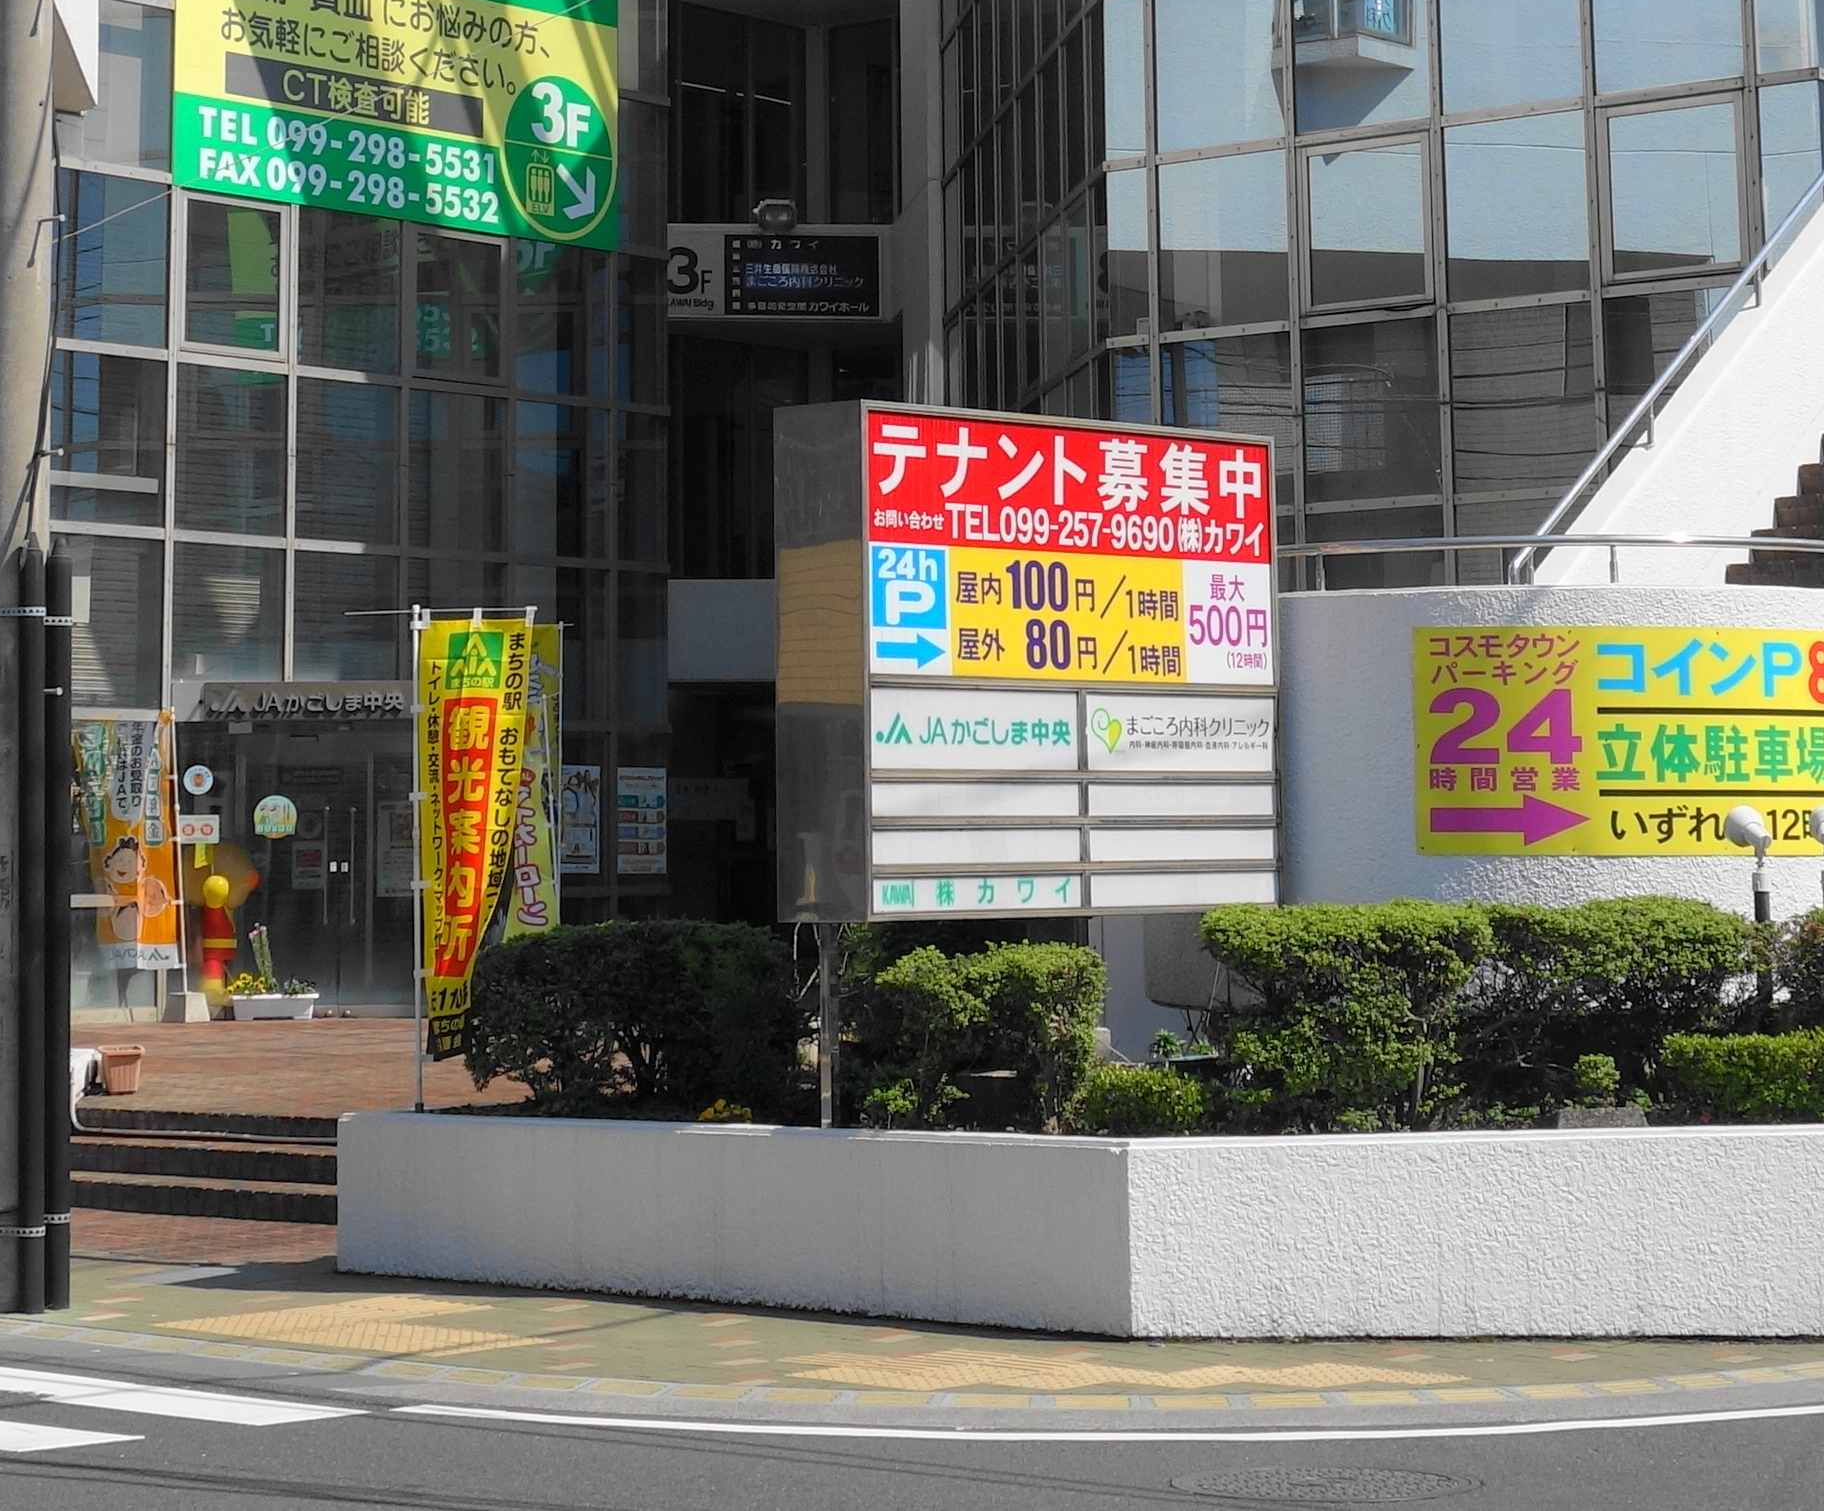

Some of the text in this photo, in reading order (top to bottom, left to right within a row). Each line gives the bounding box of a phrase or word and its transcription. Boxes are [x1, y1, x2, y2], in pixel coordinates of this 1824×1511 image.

[220, 7, 518, 96] お気軽にご相談ください。
[282, 73, 432, 126] CT検査可能
[530, 81, 593, 148] 3F
[198, 106, 497, 185] TEL 099-298-5531
[198, 147, 501, 225] FAX 099-298-5532
[872, 422, 1264, 521] テナント募集中
[873, 507, 945, 531] お問い合わせ
[945, 502, 1175, 553] TEL099-257-9690
[877, 547, 939, 582] 24h
[1208, 573, 1245, 602] 最大
[884, 582, 938, 625] P
[1188, 603, 1270, 650] 500円
[956, 626, 1005, 664] 屋外
[1225, 649, 1269, 672] (12時間)
[1428, 633, 1581, 660] コスモタウン
[1596, 637, 1803, 699] コインP
[501, 631, 527, 712] まちの駅
[1429, 660, 1579, 687] パーキング
[255, 691, 405, 713] JAかごしま中央
[917, 715, 1072, 748] JAかごしま中央
[1125, 713, 1271, 739] まごころ内科クリニック
[1428, 687, 1583, 766] 24
[1428, 768, 1582, 793] 時間営業
[446, 704, 491, 964] 観光案内所
